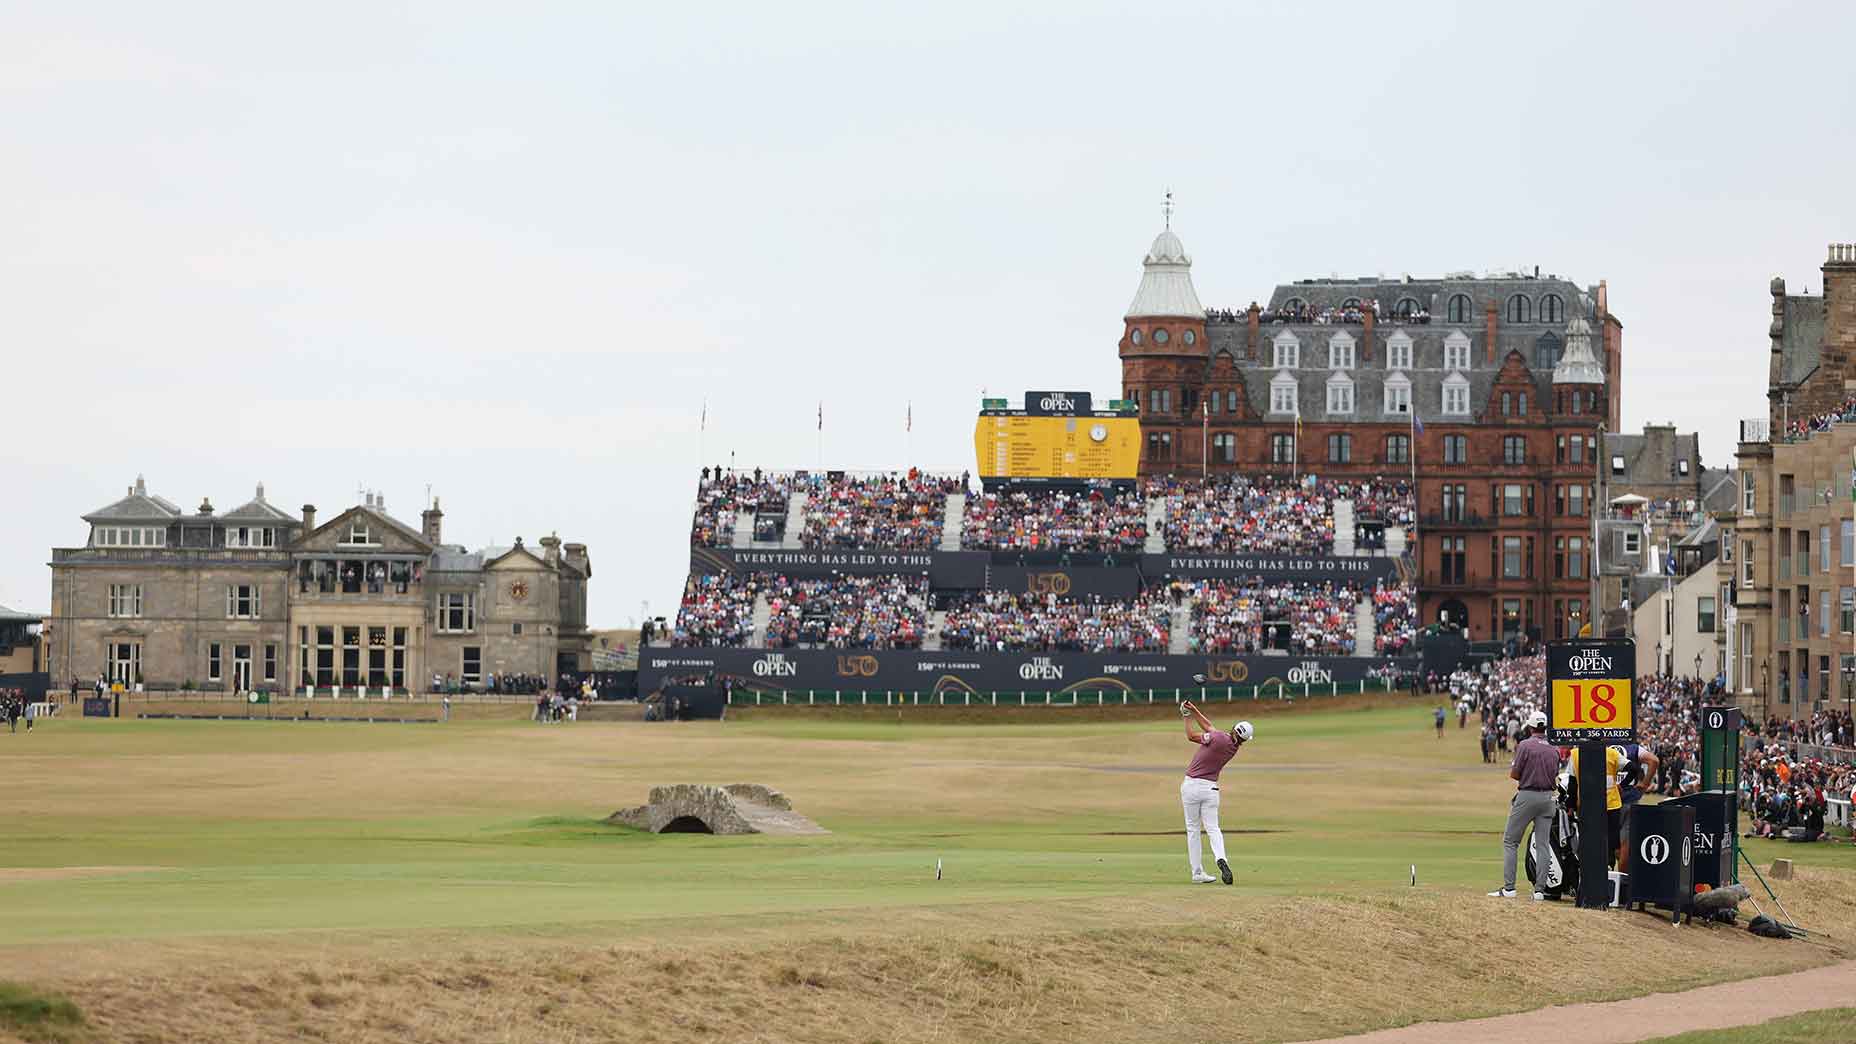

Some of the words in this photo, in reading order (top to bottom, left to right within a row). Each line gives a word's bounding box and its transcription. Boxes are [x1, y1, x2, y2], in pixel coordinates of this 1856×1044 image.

[1040, 397, 1075, 410] OPEN
[735, 553, 817, 564] EVERYTHING
[822, 554, 847, 564] HAS
[852, 554, 875, 565] LED
[880, 555, 897, 565] TO
[902, 555, 932, 565] THIS
[1170, 558, 1254, 569] EVERYTHING
[1259, 559, 1284, 569] HAS
[1289, 560, 1313, 570] LED
[1317, 560, 1335, 570] TO
[1340, 560, 1369, 570] THIS
[767, 653, 784, 661] THE
[1581, 649, 1600, 657] THE
[1032, 656, 1051, 665] THE
[1301, 661, 1320, 669] THE
[1568, 655, 1613, 671] OPEN
[752, 659, 797, 676] OPEN
[1019, 663, 1063, 680] OPEN
[1287, 667, 1332, 683] OPEN
[1568, 683, 1616, 723] 18
